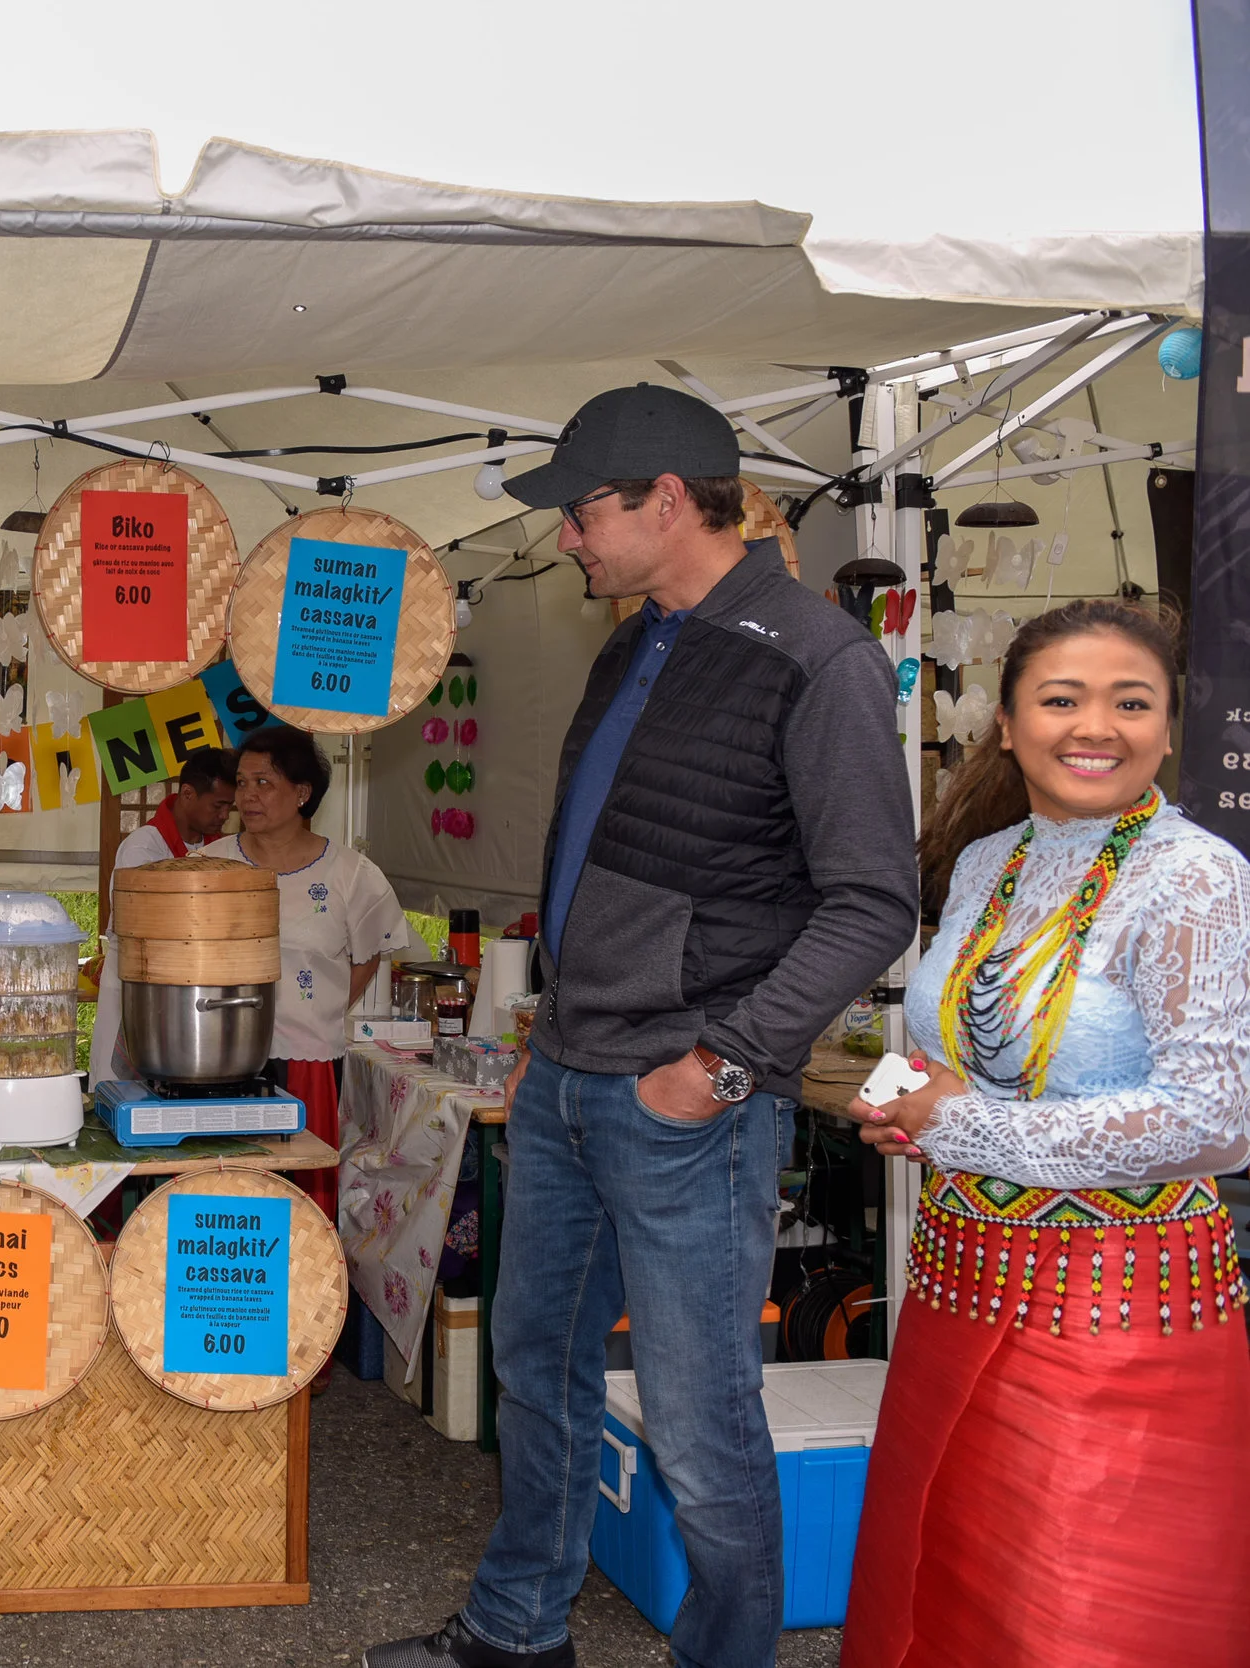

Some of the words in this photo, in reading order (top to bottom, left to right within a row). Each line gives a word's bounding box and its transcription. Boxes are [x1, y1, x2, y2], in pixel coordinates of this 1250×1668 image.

[111, 515, 154, 539] Biko
[313, 557, 377, 579] suman
[115, 585, 151, 605] 6.00
[293, 579, 393, 606] malagkit/
[300, 607, 377, 630] cassava
[311, 671, 351, 693] 6.00
[195, 1213, 261, 1231] suman
[177, 1235, 280, 1260] malagkit/
[186, 1266, 266, 1285] cassava
[0, 1288, 29, 1298] viande
[204, 1333, 245, 1354] 6.00
